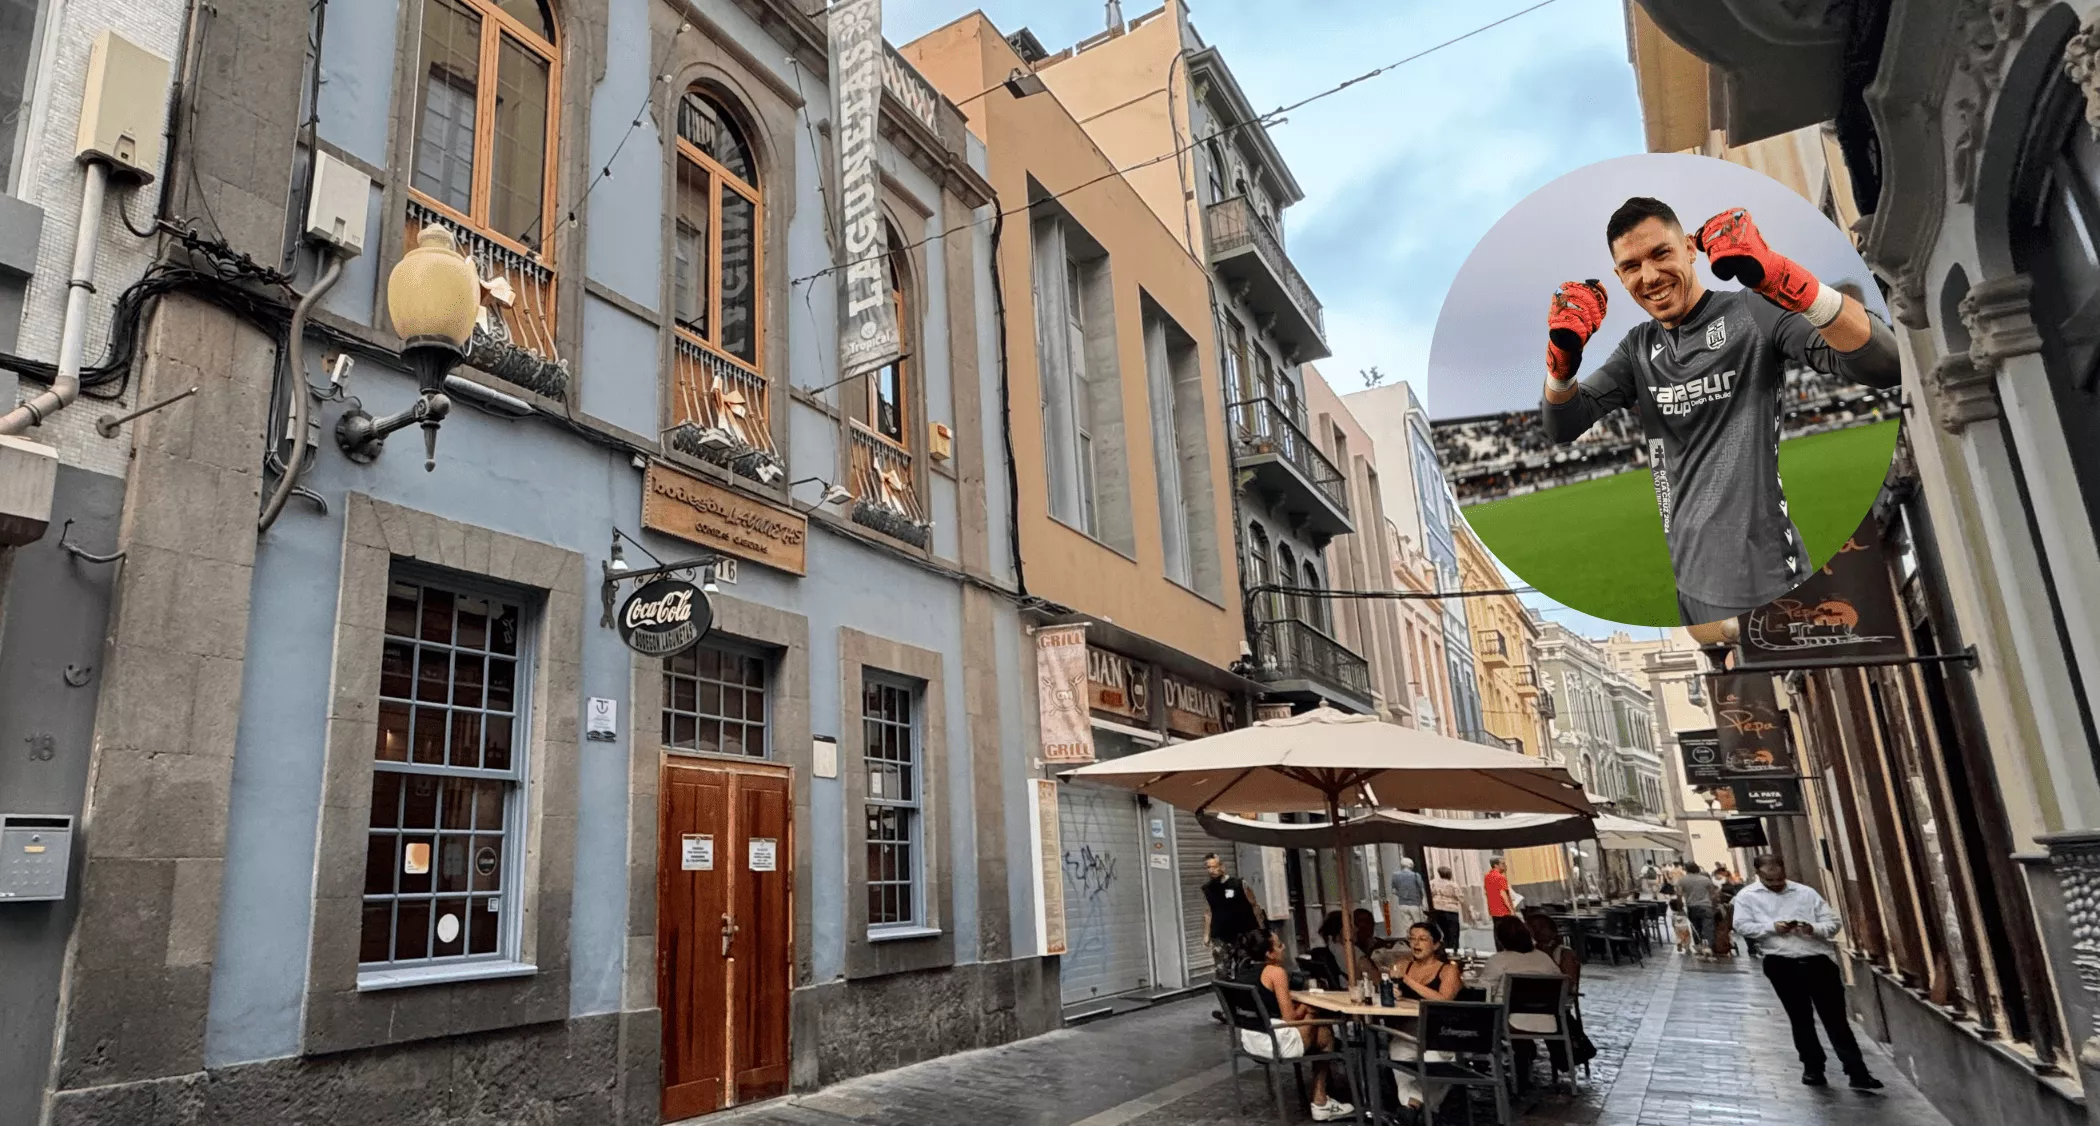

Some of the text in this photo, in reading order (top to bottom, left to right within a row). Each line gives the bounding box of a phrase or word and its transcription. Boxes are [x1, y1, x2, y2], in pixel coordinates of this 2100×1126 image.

[839, 40, 884, 318] LAGUNETAS
[849, 328, 891, 354] Tropical
[718, 560, 736, 581] 16
[1040, 633, 1082, 648] GRILL
[1087, 649, 1123, 688] LIAN
[1714, 679, 1740, 705] La
[1719, 709, 1778, 740] Pepa
[1046, 743, 1091, 757] GRILL
